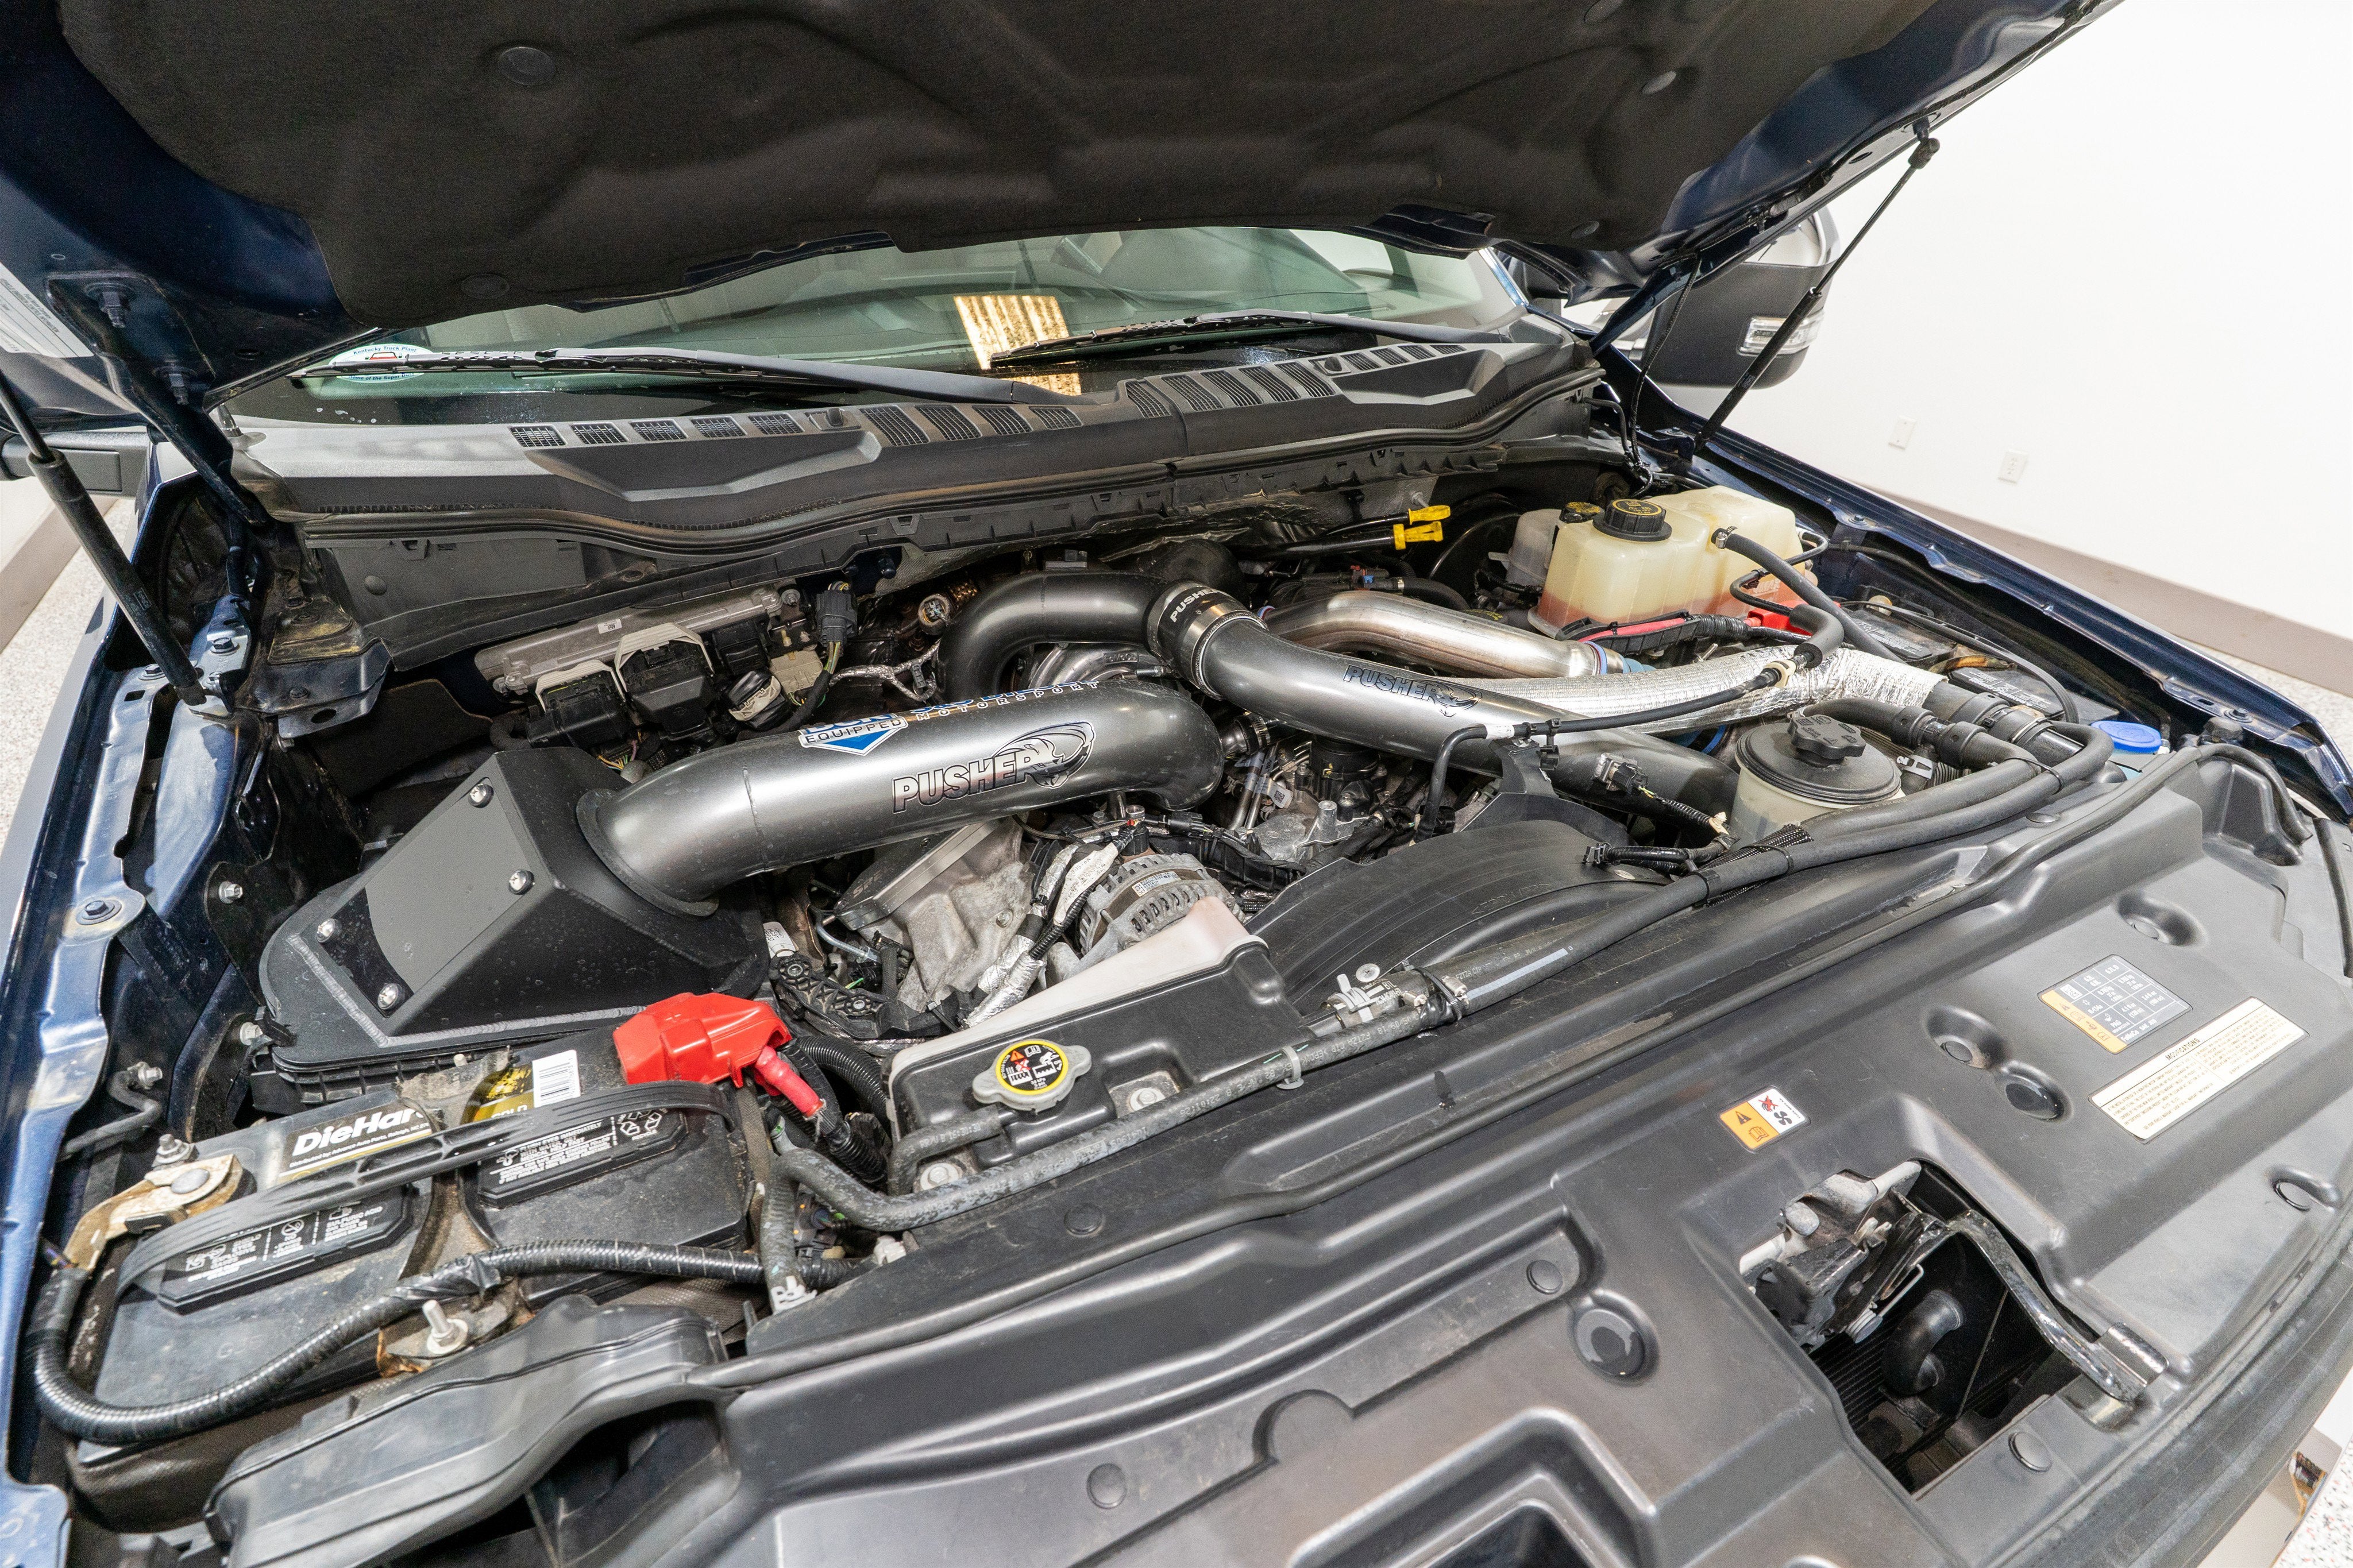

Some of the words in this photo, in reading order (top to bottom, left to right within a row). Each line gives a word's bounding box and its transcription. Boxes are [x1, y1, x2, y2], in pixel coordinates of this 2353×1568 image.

[353, 346, 381, 355] Kentucky
[1343, 665, 1437, 704] PUSHER
[916, 682, 1099, 720] MOTORSPORT
[805, 719, 902, 744] EQUIPPED
[892, 749, 1033, 814] PUSHER
[2165, 1037, 2200, 1061] MODIFICATIONS
[292, 1108, 425, 1157] DieHar
[560, 1122, 602, 1140] IMMEDIATELY
[290, 1155, 322, 1168] Distributed
[331, 1144, 357, 1154] Advance
[357, 1139, 371, 1147] Auto
[520, 1149, 549, 1162] MEDICAL
